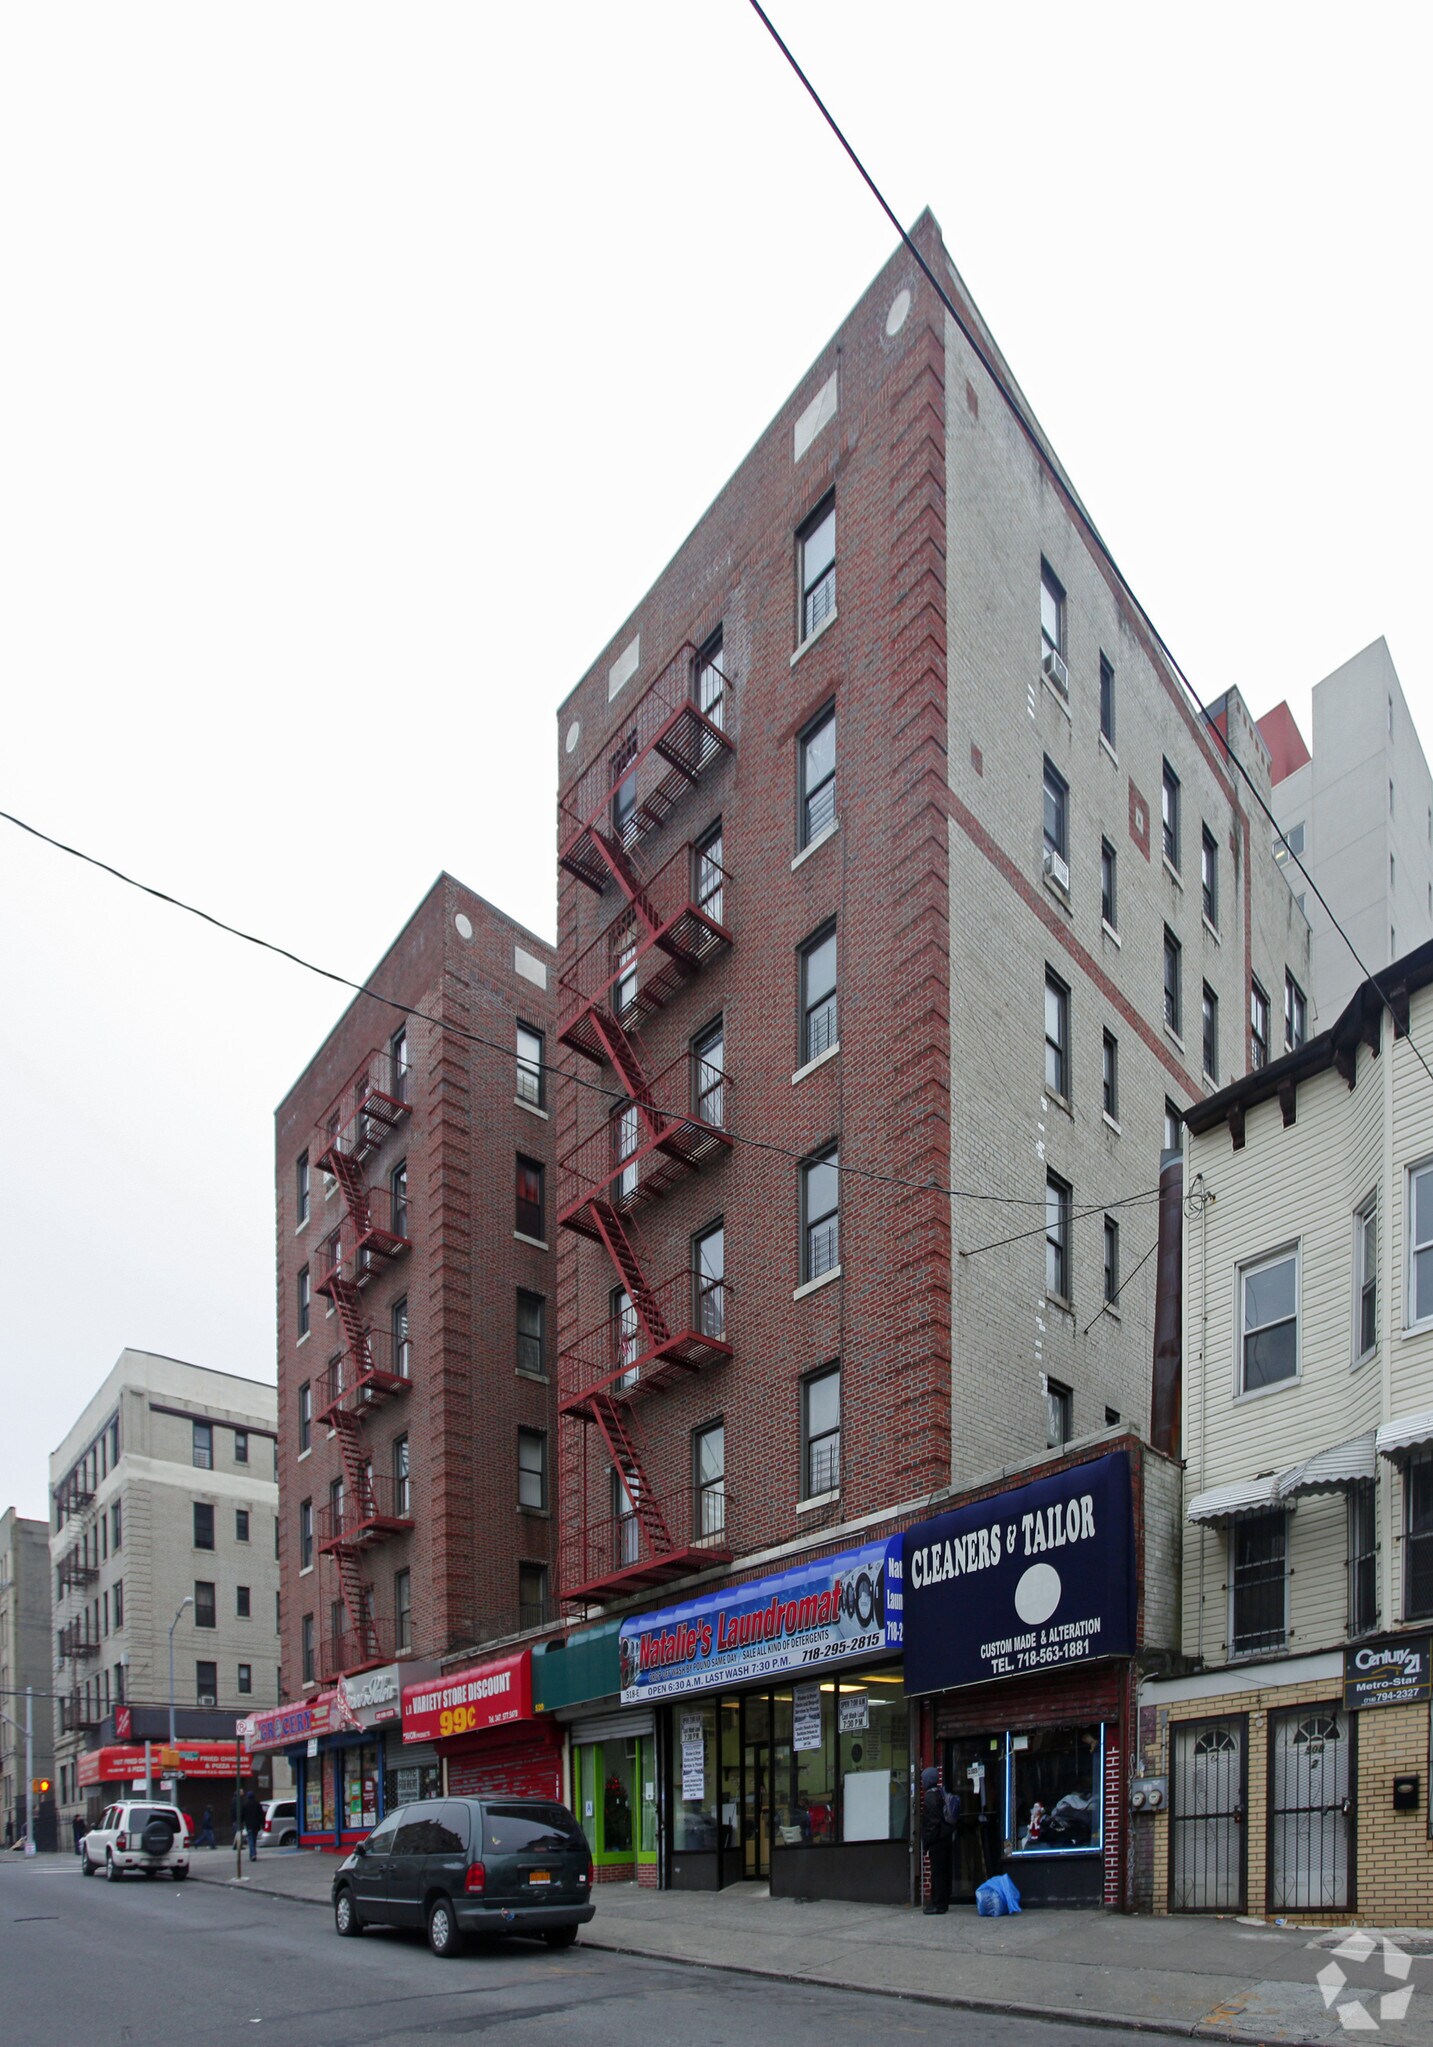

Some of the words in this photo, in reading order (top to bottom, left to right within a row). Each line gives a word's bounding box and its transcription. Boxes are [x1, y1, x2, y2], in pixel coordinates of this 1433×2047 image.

[911, 1524, 1001, 1589] CLEANERS
[1006, 1524, 1017, 1554] &
[1022, 1495, 1096, 1556] TAILOR
[639, 1618, 712, 1671] Natalie's
[717, 1580, 842, 1652] Laundromat
[980, 1638, 1012, 1659] CUSTOM
[1014, 1632, 1036, 1651] MADE
[1040, 1630, 1047, 1645] &
[1049, 1617, 1101, 1643] ALTERATION
[648, 1684, 667, 1696] OPEN
[668, 1680, 685, 1692] 6:30
[686, 1677, 703, 1688] A.M.
[705, 1671, 724, 1683] LAST
[724, 1665, 749, 1679] WASH
[752, 1660, 770, 1673] 7:30
[772, 1656, 791, 1669] P.M.
[802, 1632, 880, 1662] 718-295-2815
[672, 1666, 686, 1677] WASH
[686, 1664, 693, 1674] BY
[693, 1660, 711, 1672] POUND
[711, 1656, 726, 1667] SAME
[727, 1653, 737, 1663] DAY
[742, 1648, 757, 1660] SALE
[757, 1645, 767, 1657] ALL
[767, 1642, 781, 1654] KIND
[782, 1640, 791, 1651] OF
[791, 1630, 829, 1648] DETERGENTS
[991, 1656, 1014, 1674] TEL.
[1017, 1639, 1089, 1668] 718-563-1881
[1355, 1648, 1410, 1670] Century
[1404, 1653, 1420, 1675] 21
[412, 1691, 442, 1714] VARIETY
[443, 1684, 467, 1708] STORE
[468, 1671, 511, 1701] DISCOUNT
[1356, 1676, 1417, 1692] Metro-Star
[1376, 1688, 1419, 1701] 794-2327
[260, 1710, 312, 1742] GROCERY
[440, 1705, 476, 1736] 99¢
[843, 1720, 854, 1729] 7:30
